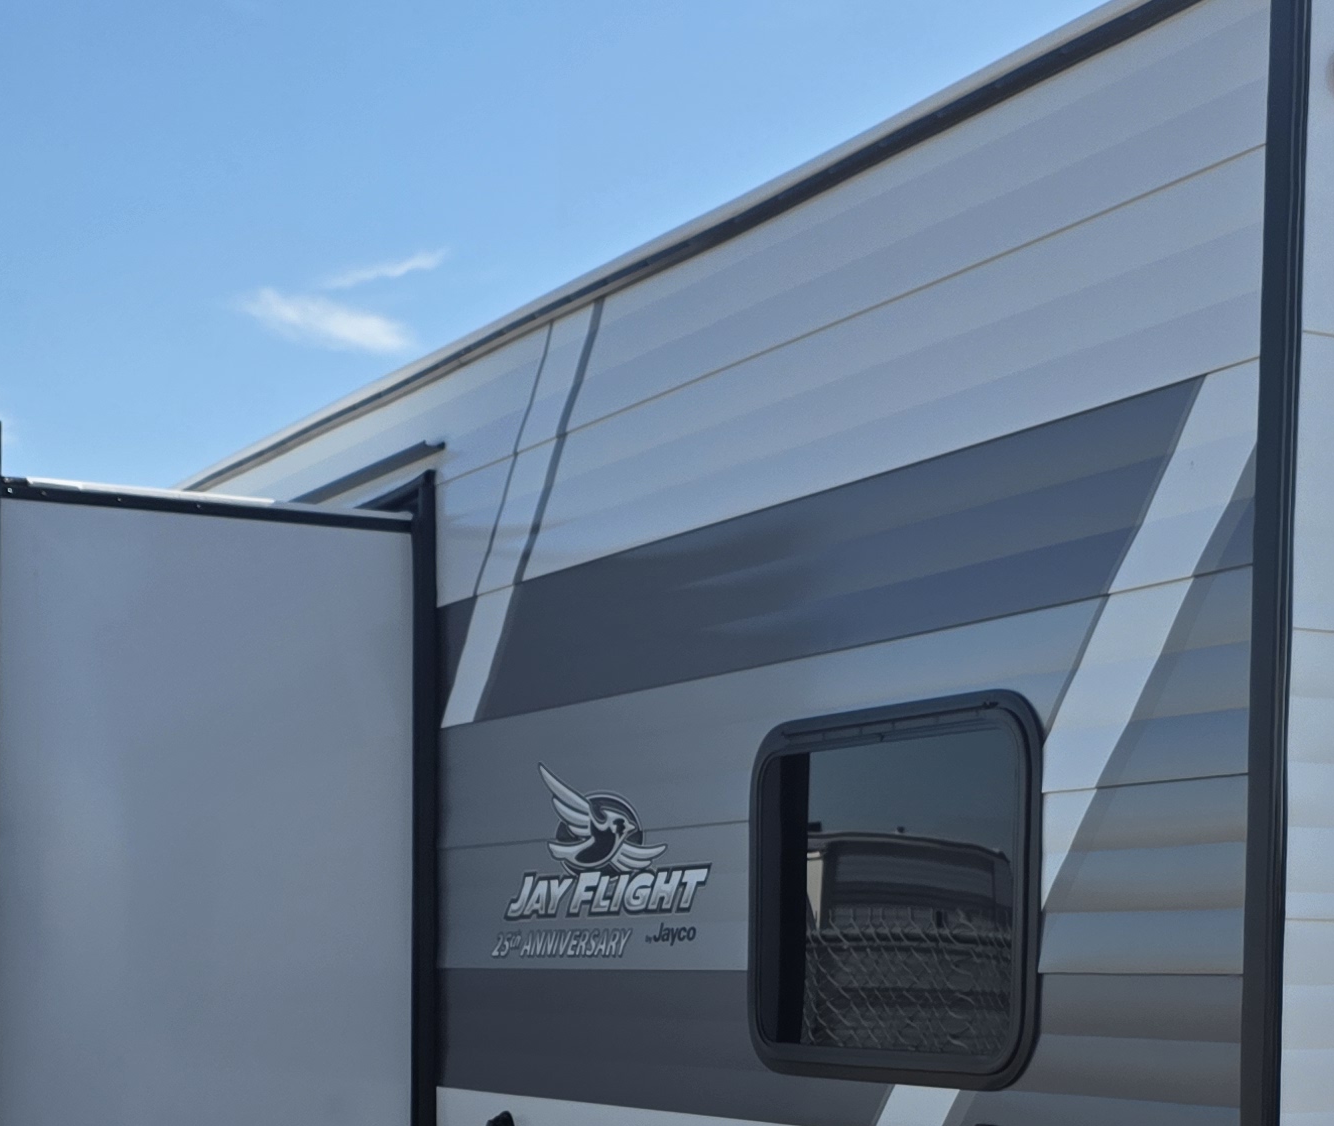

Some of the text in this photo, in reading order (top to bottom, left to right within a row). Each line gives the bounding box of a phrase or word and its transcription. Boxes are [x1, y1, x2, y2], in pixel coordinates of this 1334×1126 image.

[504, 863, 712, 920] JAY FLIGHT
[491, 928, 633, 958] 25th ANNIVERSARY
[653, 922, 697, 946] Jayco
